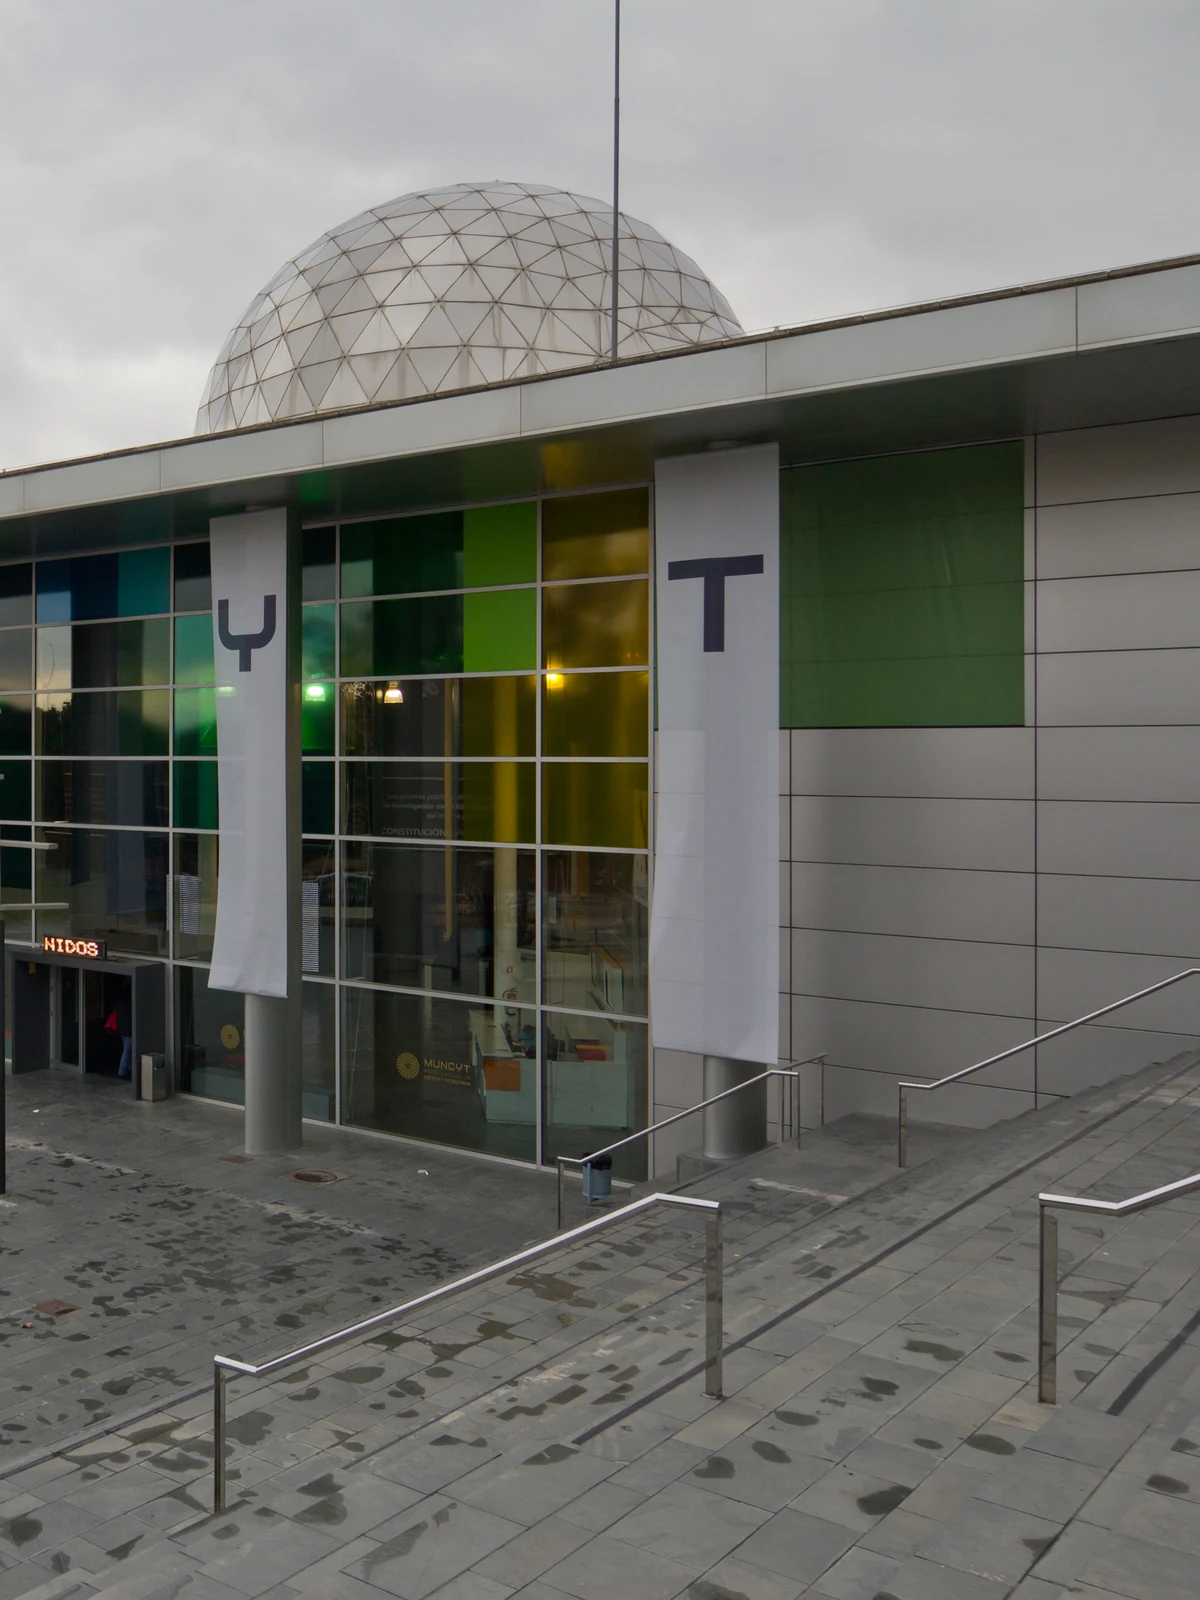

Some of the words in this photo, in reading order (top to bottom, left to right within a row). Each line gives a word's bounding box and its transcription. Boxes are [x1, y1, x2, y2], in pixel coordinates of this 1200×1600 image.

[668, 554, 764, 652] T
[218, 594, 276, 672] Y
[382, 827, 446, 837] CONSTITUCIÓN
[44, 937, 99, 957] NIDOS
[424, 1058, 471, 1073] MUNCYT
